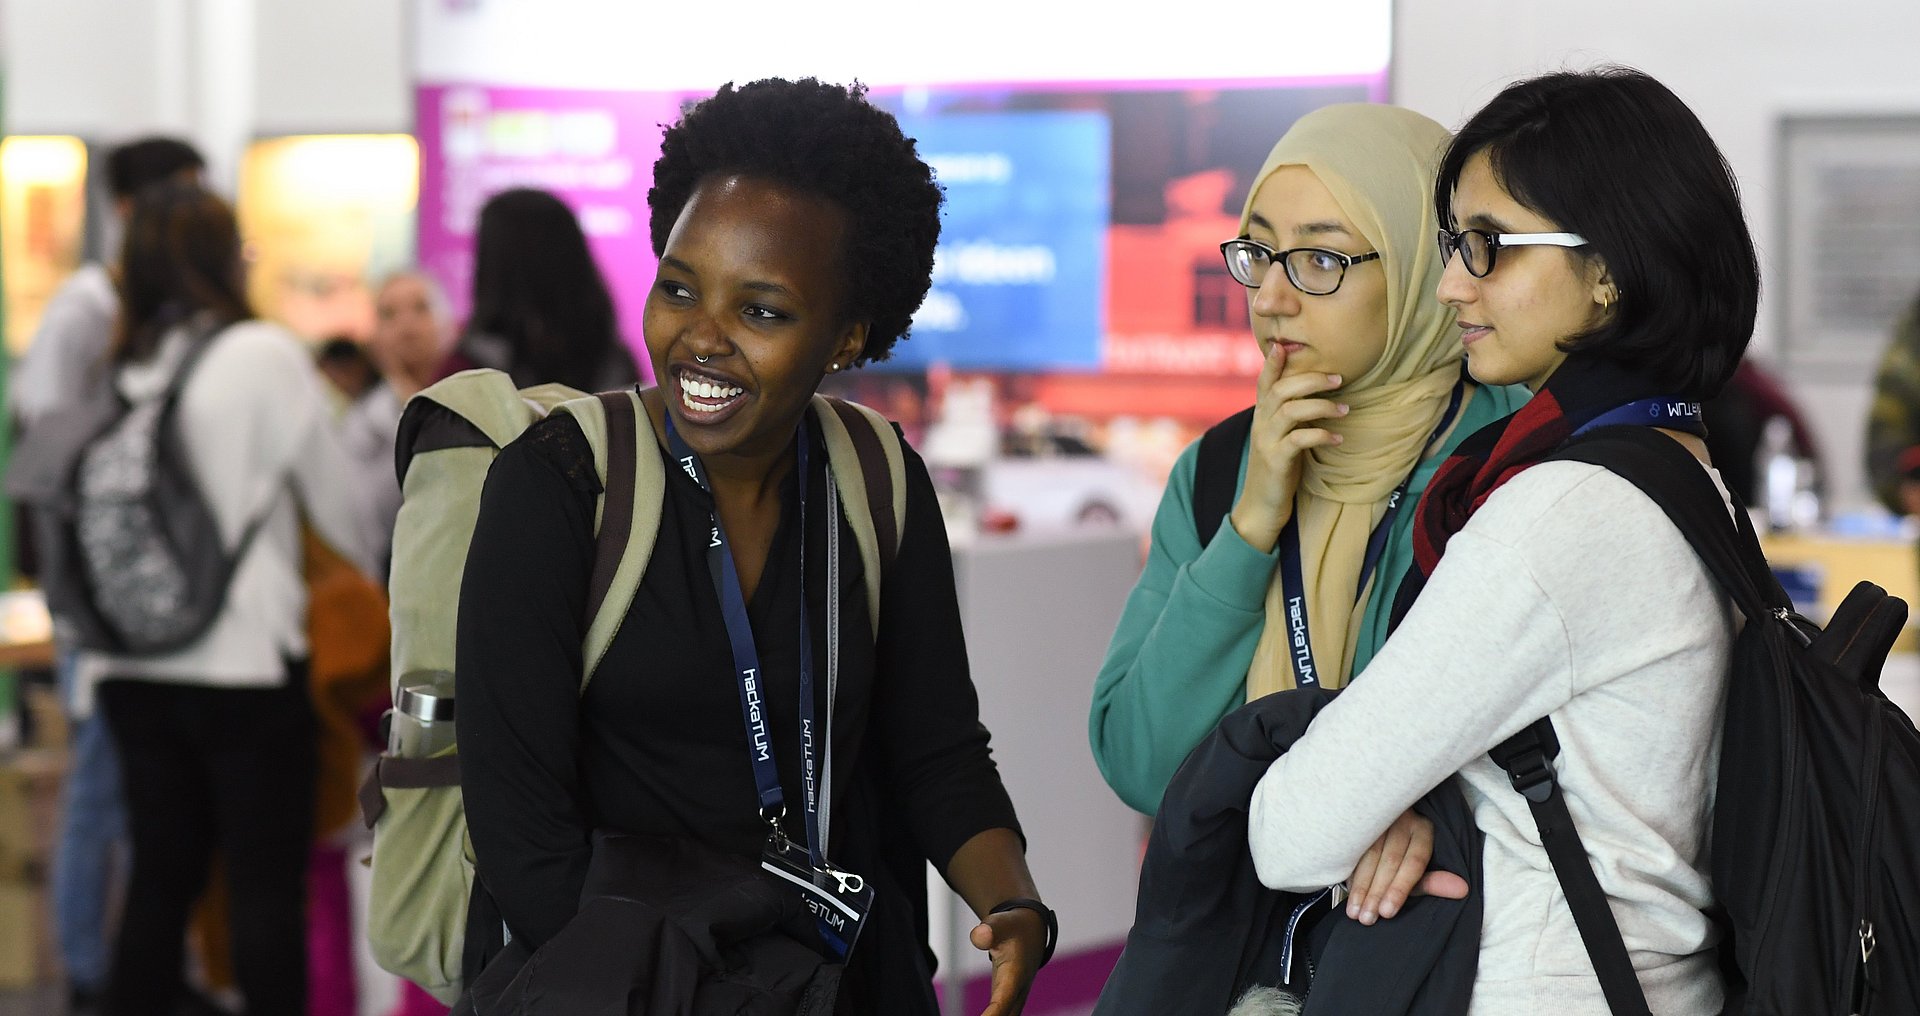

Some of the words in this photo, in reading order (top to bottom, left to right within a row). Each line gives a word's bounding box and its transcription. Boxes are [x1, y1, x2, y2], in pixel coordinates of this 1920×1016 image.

[1289, 596, 1315, 685] hackaTUM
[743, 668, 770, 762] hackaTUM
[803, 719, 816, 813] hackaTUM
